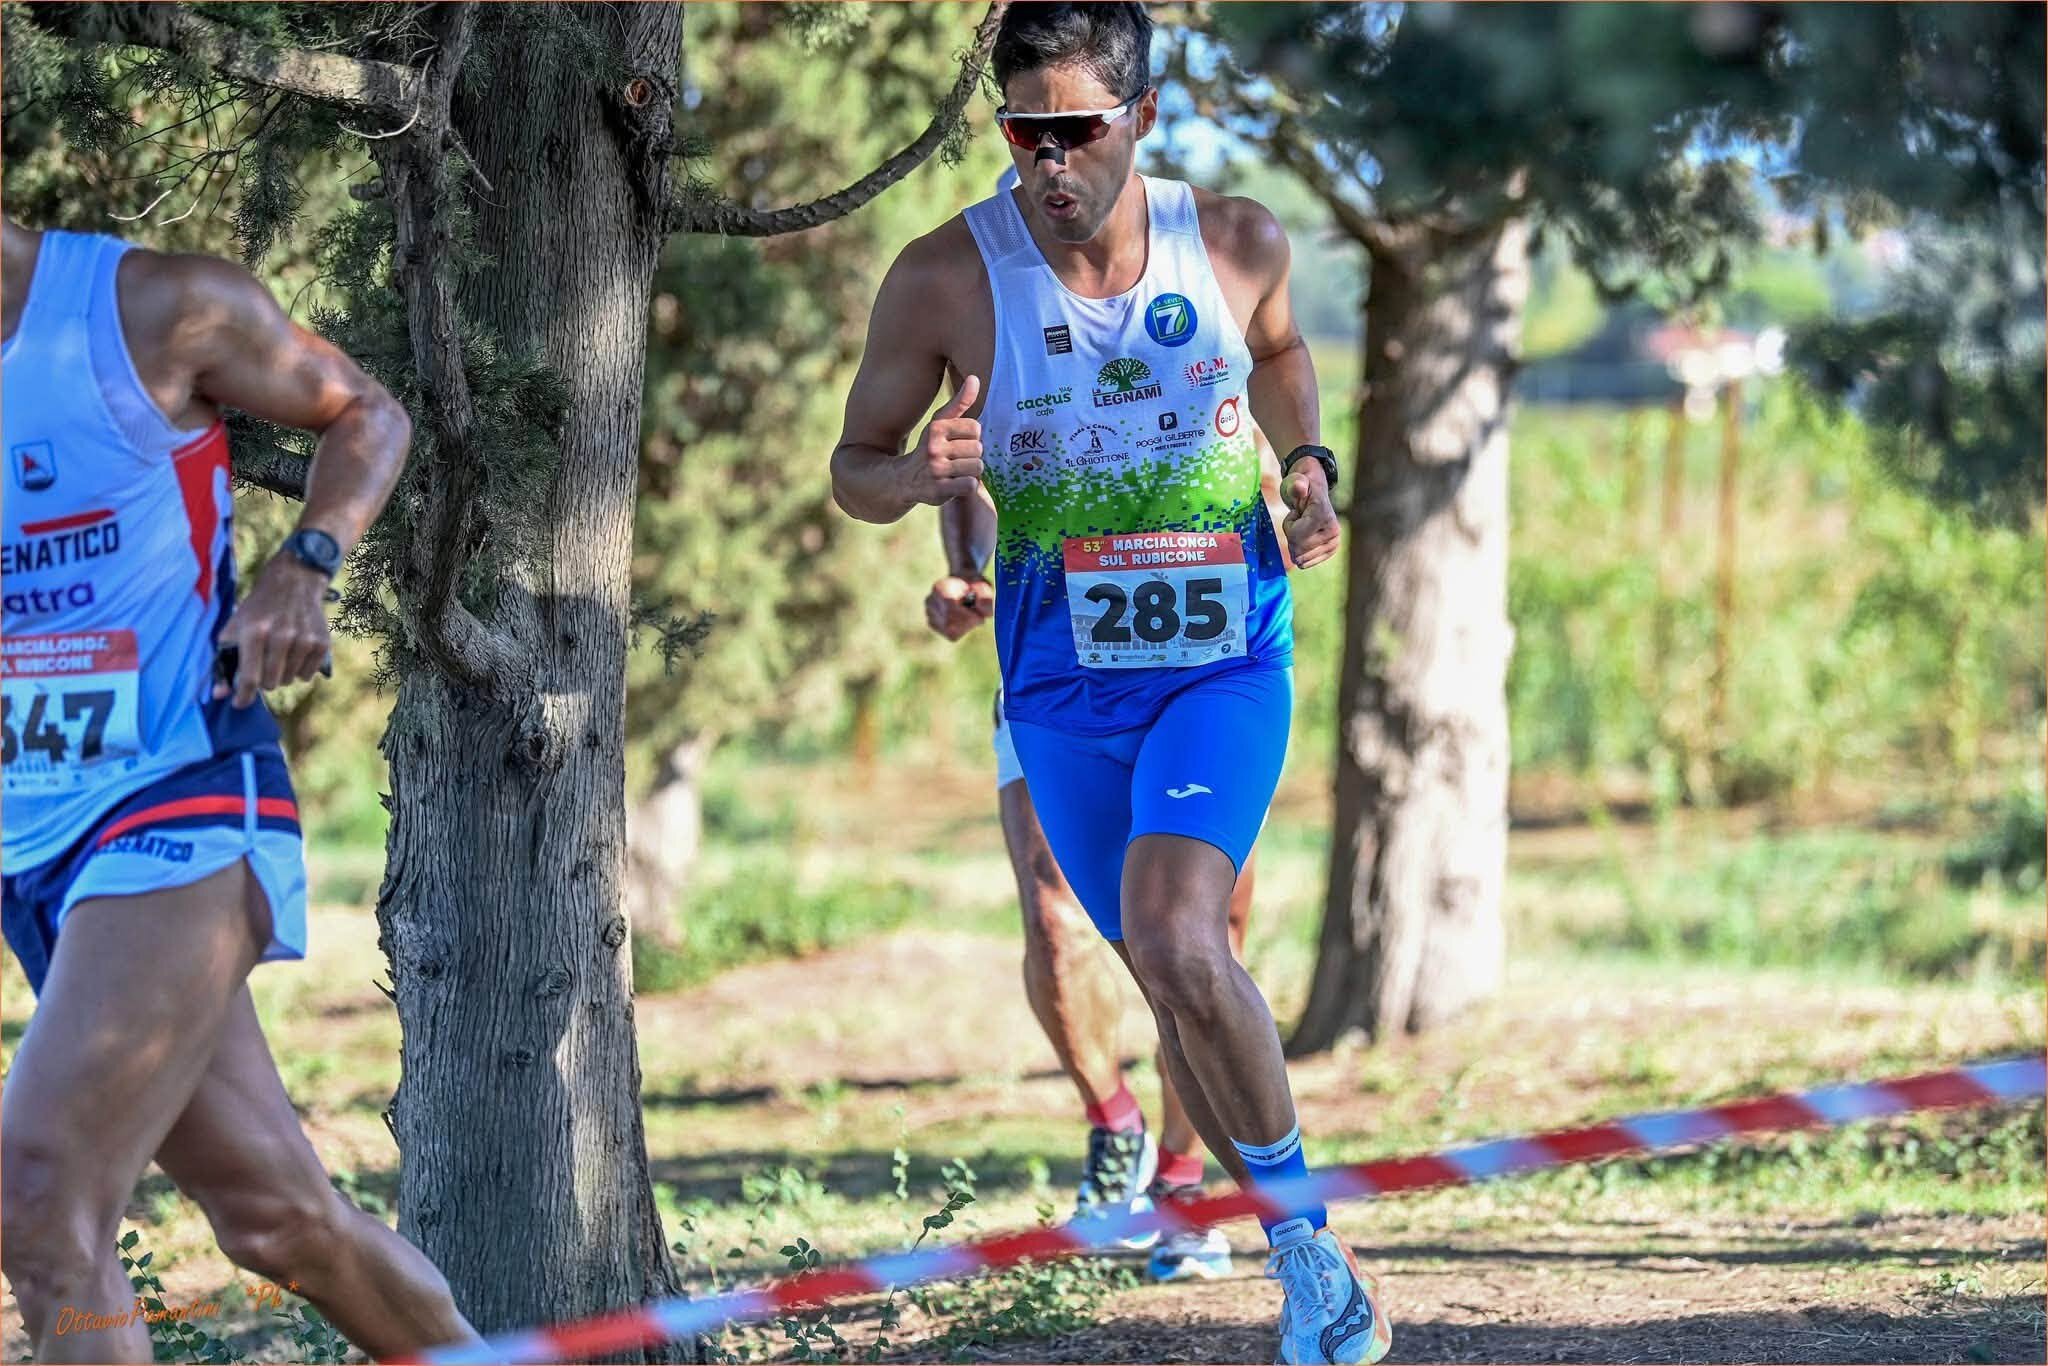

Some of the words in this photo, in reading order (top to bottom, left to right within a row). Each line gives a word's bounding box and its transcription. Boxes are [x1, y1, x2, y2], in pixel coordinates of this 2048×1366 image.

[1156, 306, 1181, 334] 7
[1016, 391, 1072, 411] cactus
[1093, 385, 1162, 408] LEGNAMI
[1010, 429, 1047, 453] BRK
[1135, 437, 1162, 449] POGGI
[1164, 429, 1206, 442] GILBERTO
[1, 521, 120, 576] ENATICO
[1113, 537, 1218, 552] MARCIALONGA
[1099, 554, 1127, 567] SUL
[1132, 550, 1206, 565] RUBICONE
[1084, 577, 1228, 643] 285
